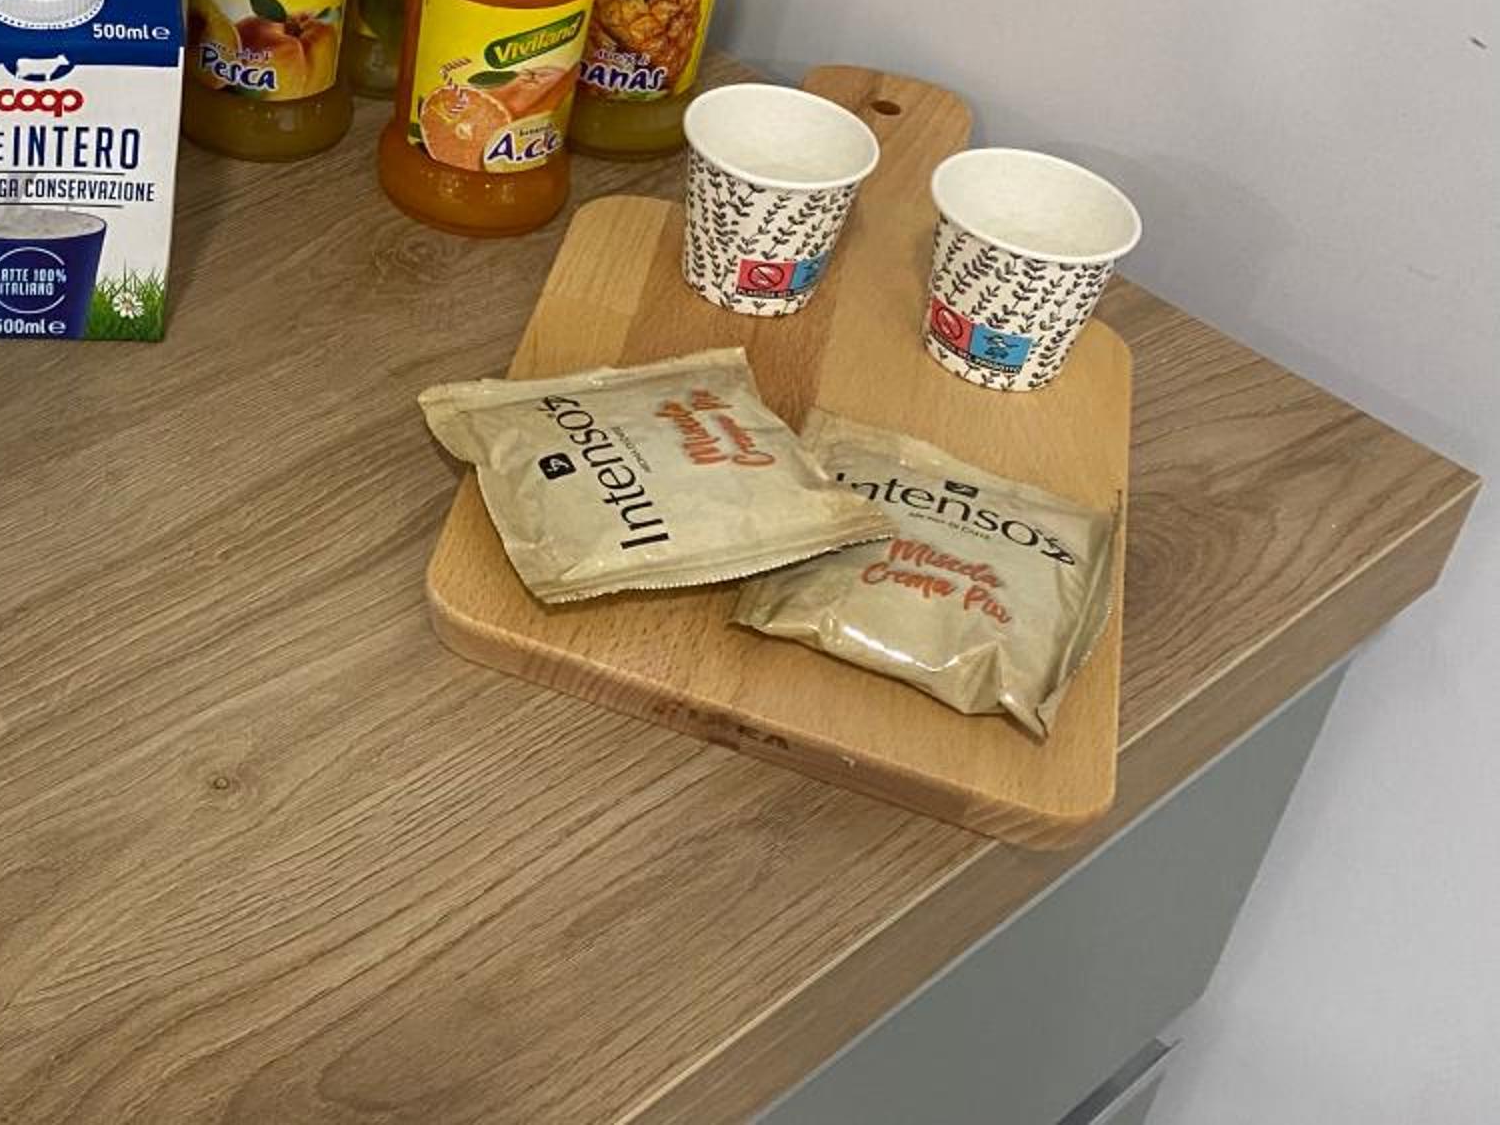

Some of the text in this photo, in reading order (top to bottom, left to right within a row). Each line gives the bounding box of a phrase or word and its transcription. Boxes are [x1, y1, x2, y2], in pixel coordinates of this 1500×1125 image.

[92, 24, 150, 40] 500ml
[12, 125, 141, 170] INTERO
[25, 179, 155, 202] CONSERVAZIONE
[33, 268, 67, 283] 100%
[0, 282, 54, 296] ITALIANO
[860, 561, 957, 600] Crema
